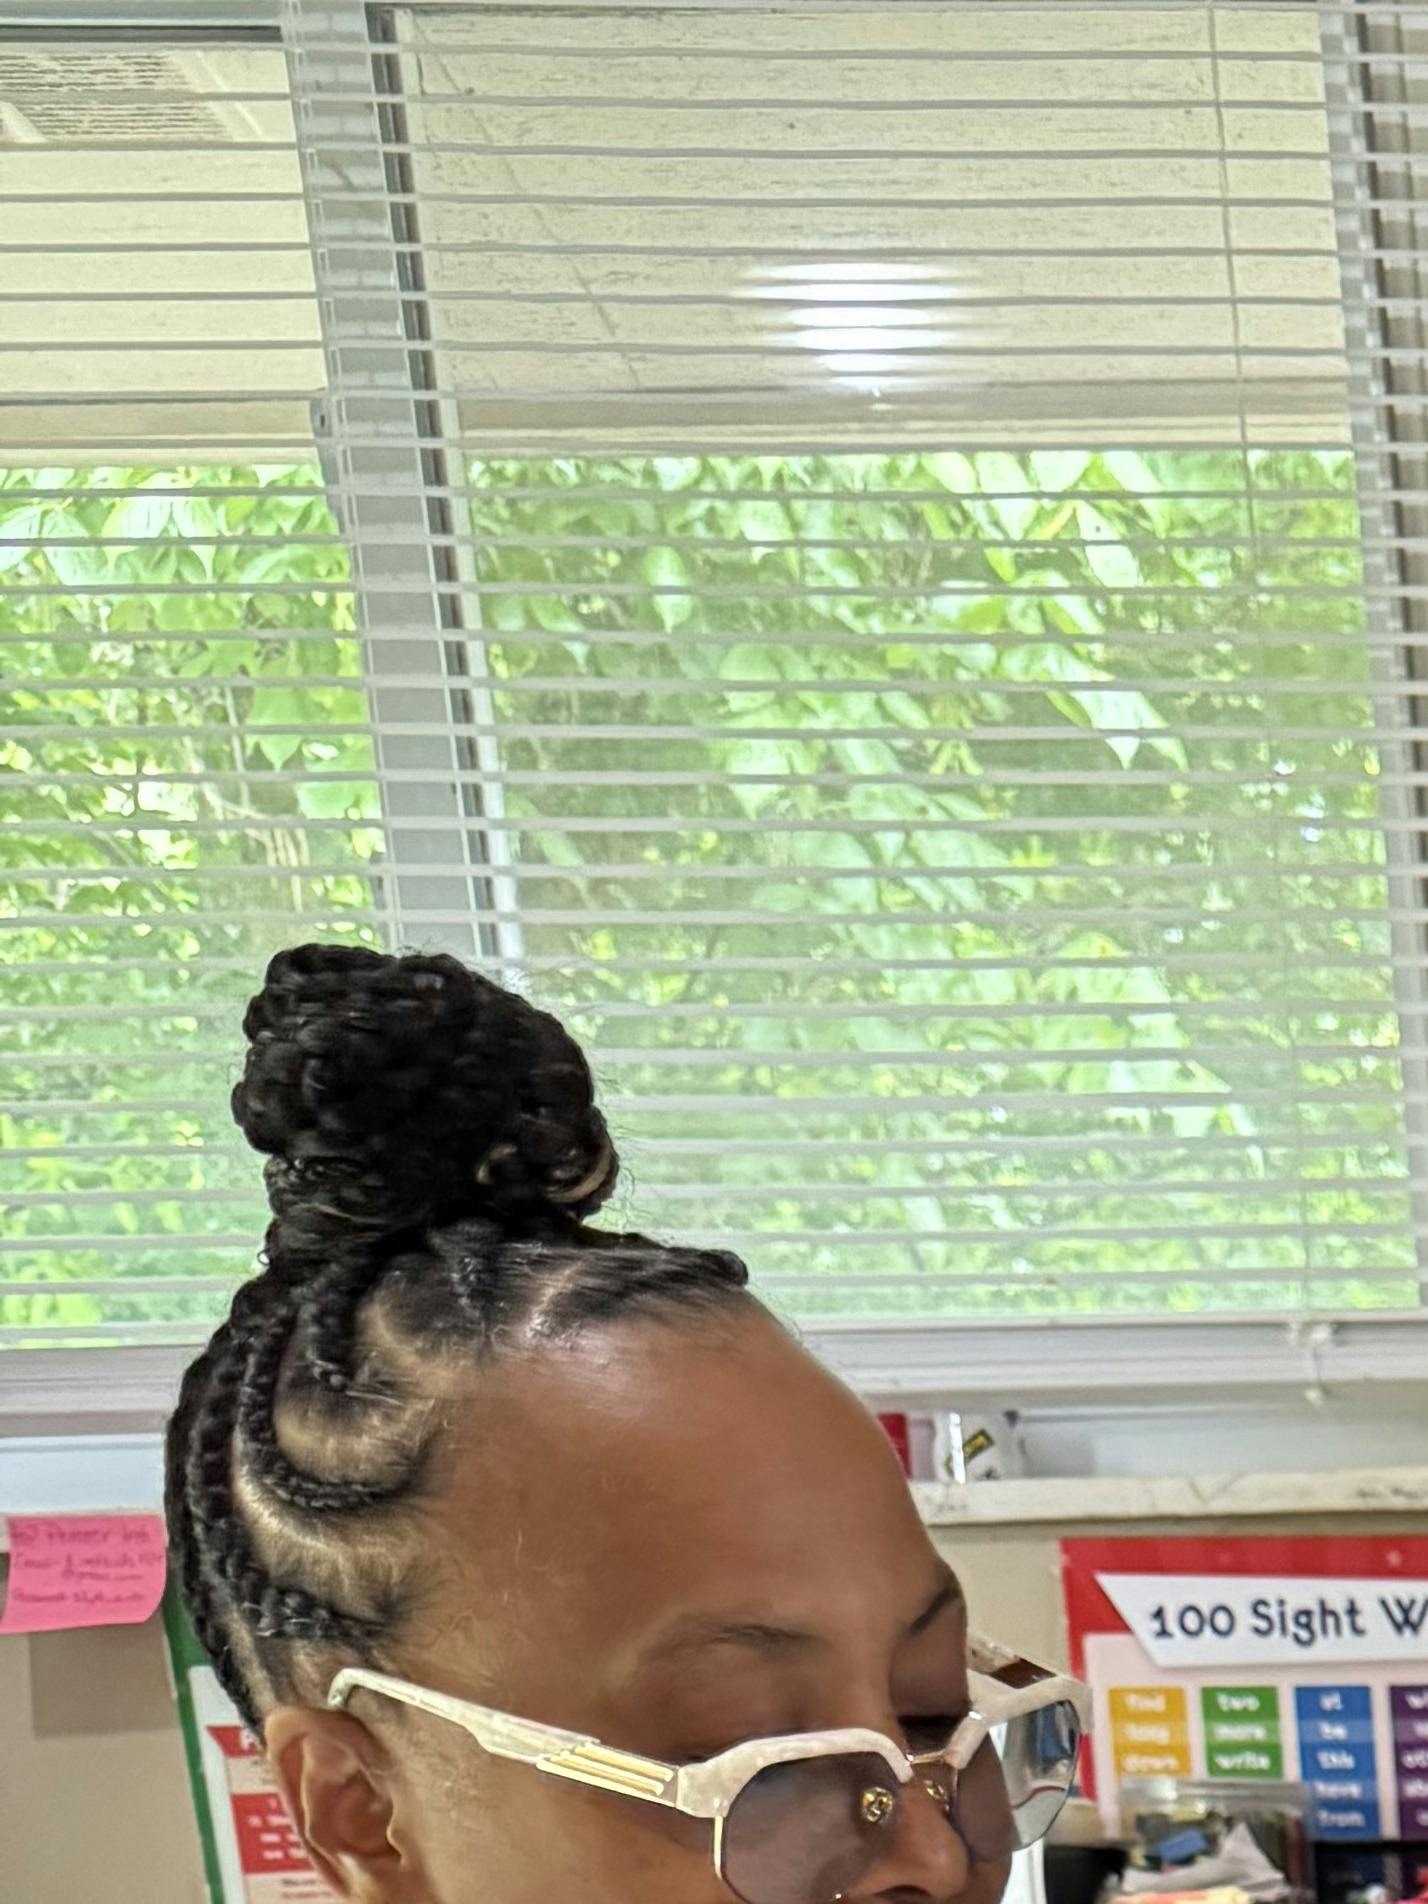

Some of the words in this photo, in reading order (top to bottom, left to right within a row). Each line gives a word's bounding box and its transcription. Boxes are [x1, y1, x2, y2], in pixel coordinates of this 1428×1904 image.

[1150, 1604, 1236, 1639] 100
[1250, 1596, 1366, 1648] Sight
[1213, 1750, 1272, 1771] write
[1316, 1750, 1355, 1770] this
